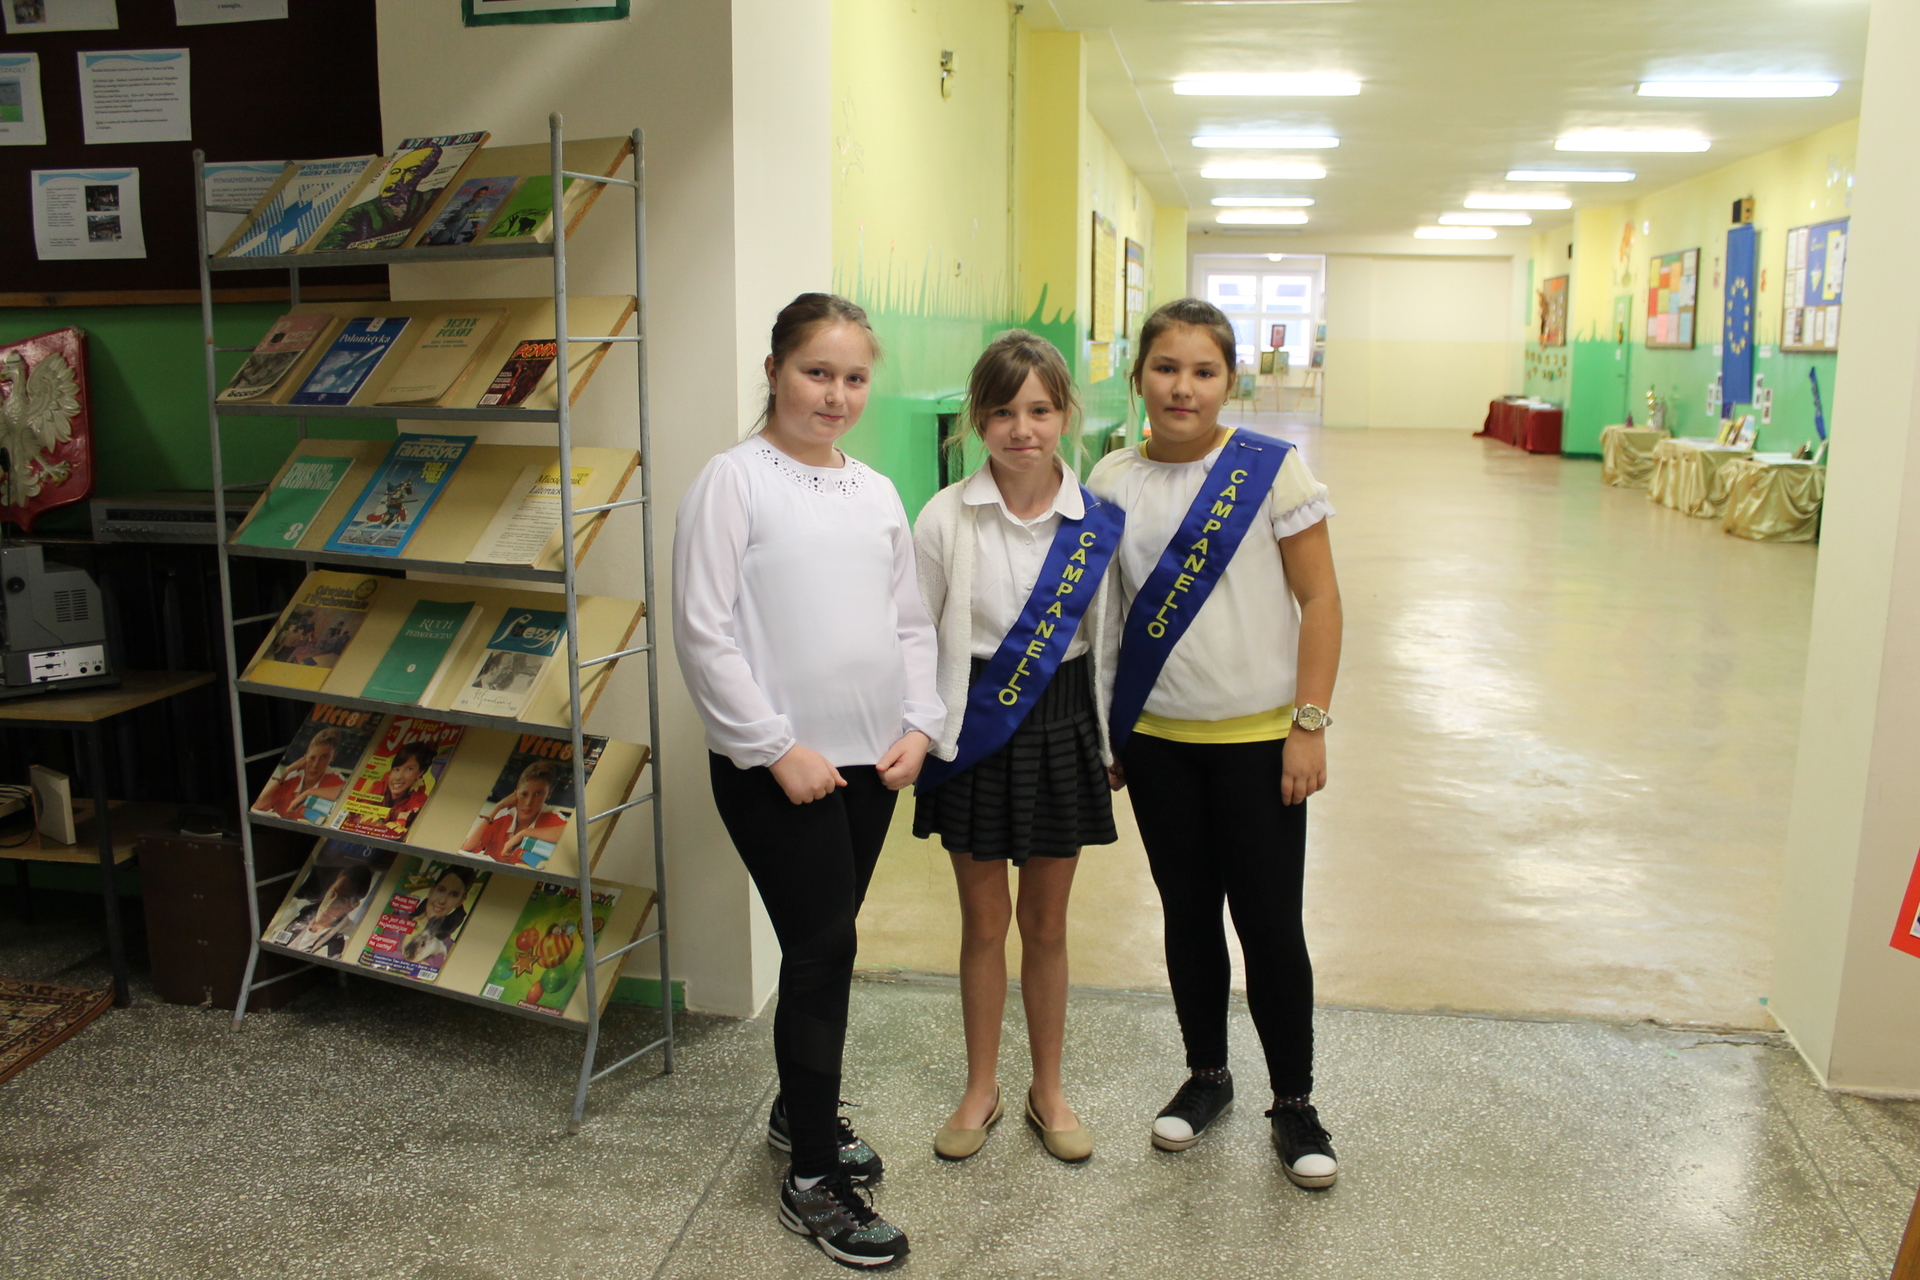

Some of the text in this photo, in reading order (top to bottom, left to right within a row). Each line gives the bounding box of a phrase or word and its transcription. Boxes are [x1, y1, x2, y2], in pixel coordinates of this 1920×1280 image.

[339, 334, 391, 345] Polonistyka
[436, 328, 474, 338] POLSKI
[395, 441, 467, 460] Fantastyka
[1147, 469, 1249, 638] CAMPANELLO
[419, 619, 455, 632] RUCH
[998, 531, 1096, 706] CAMPANELLO
[413, 720, 439, 732] Victor
[387, 719, 460, 751] Junior
